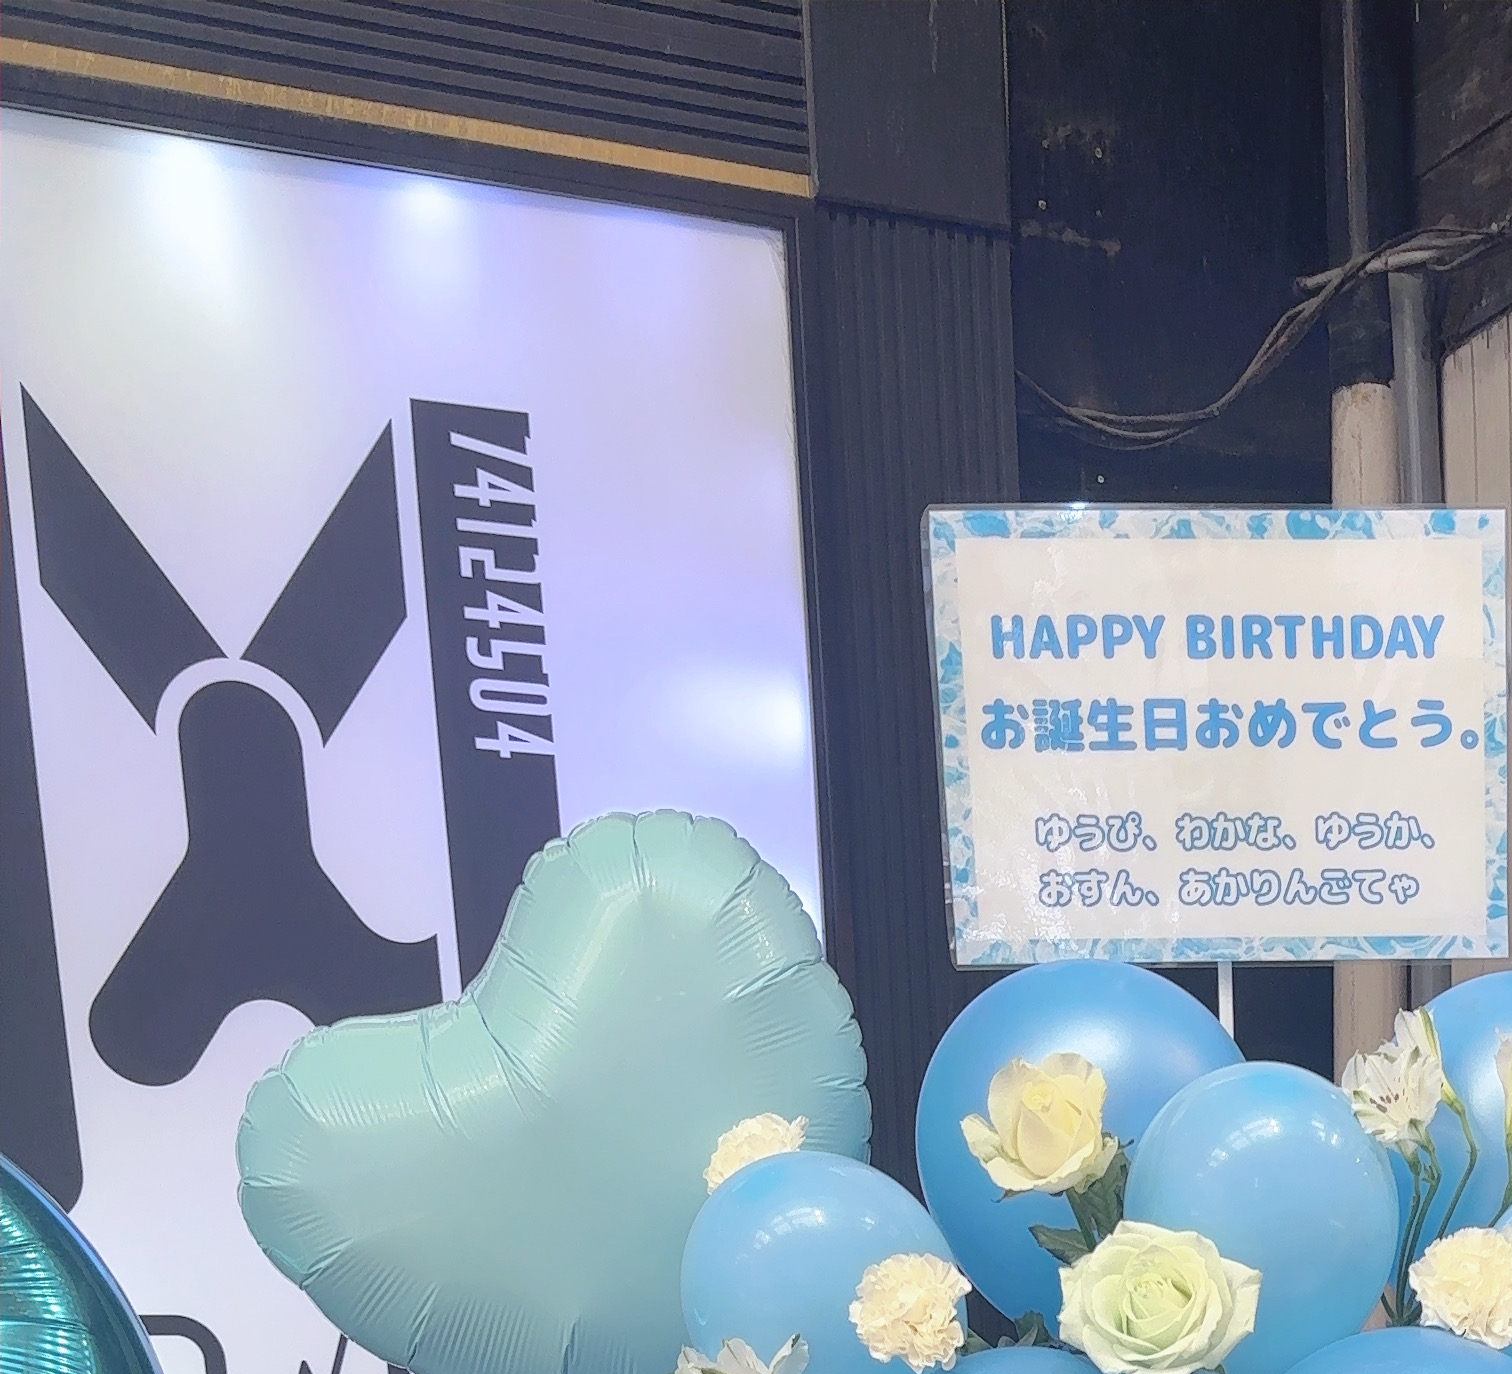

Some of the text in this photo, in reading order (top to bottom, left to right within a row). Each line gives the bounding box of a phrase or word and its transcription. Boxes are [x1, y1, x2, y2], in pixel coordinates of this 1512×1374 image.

[990, 614, 1445, 660] HAPPY BIRTHDAY
[980, 698, 1480, 753] お誕生日おめでとう。
